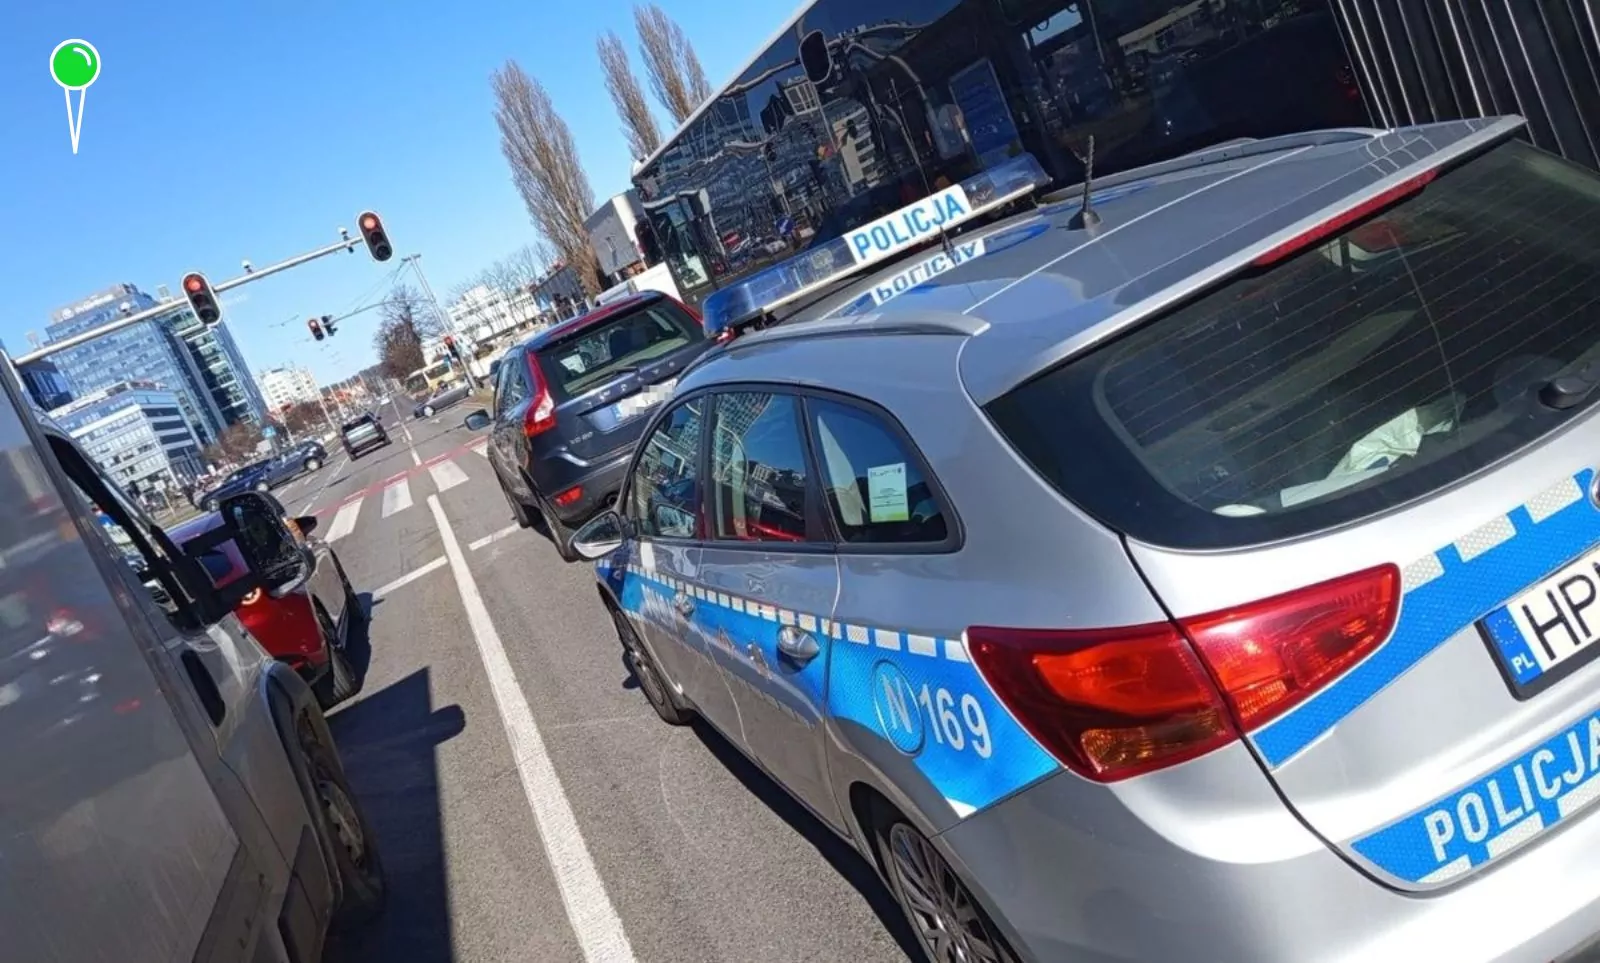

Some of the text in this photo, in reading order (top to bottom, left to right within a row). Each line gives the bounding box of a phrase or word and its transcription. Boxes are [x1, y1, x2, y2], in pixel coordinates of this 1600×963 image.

[853, 194, 965, 260] POLICJA
[1521, 562, 1600, 661] HP
[1511, 652, 1535, 674] PL
[881, 673, 993, 760] N 169
